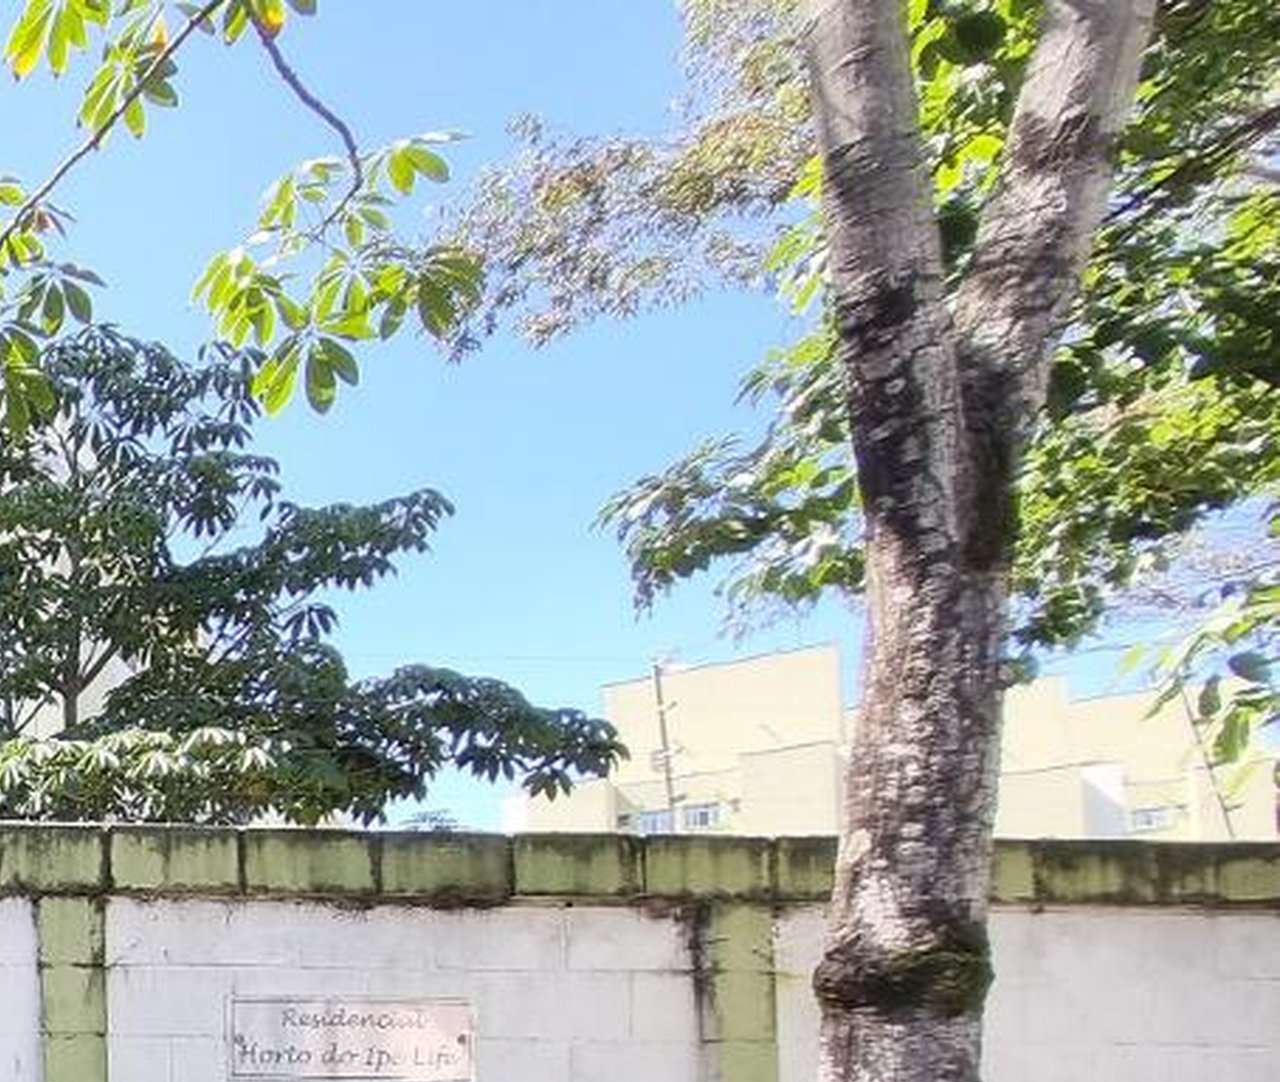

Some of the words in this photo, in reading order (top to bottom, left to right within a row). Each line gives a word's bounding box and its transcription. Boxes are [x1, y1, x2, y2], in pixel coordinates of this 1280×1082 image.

[281, 1006, 427, 1030] Residencial
[240, 1043, 312, 1066] Horto
[322, 1043, 359, 1066] do
